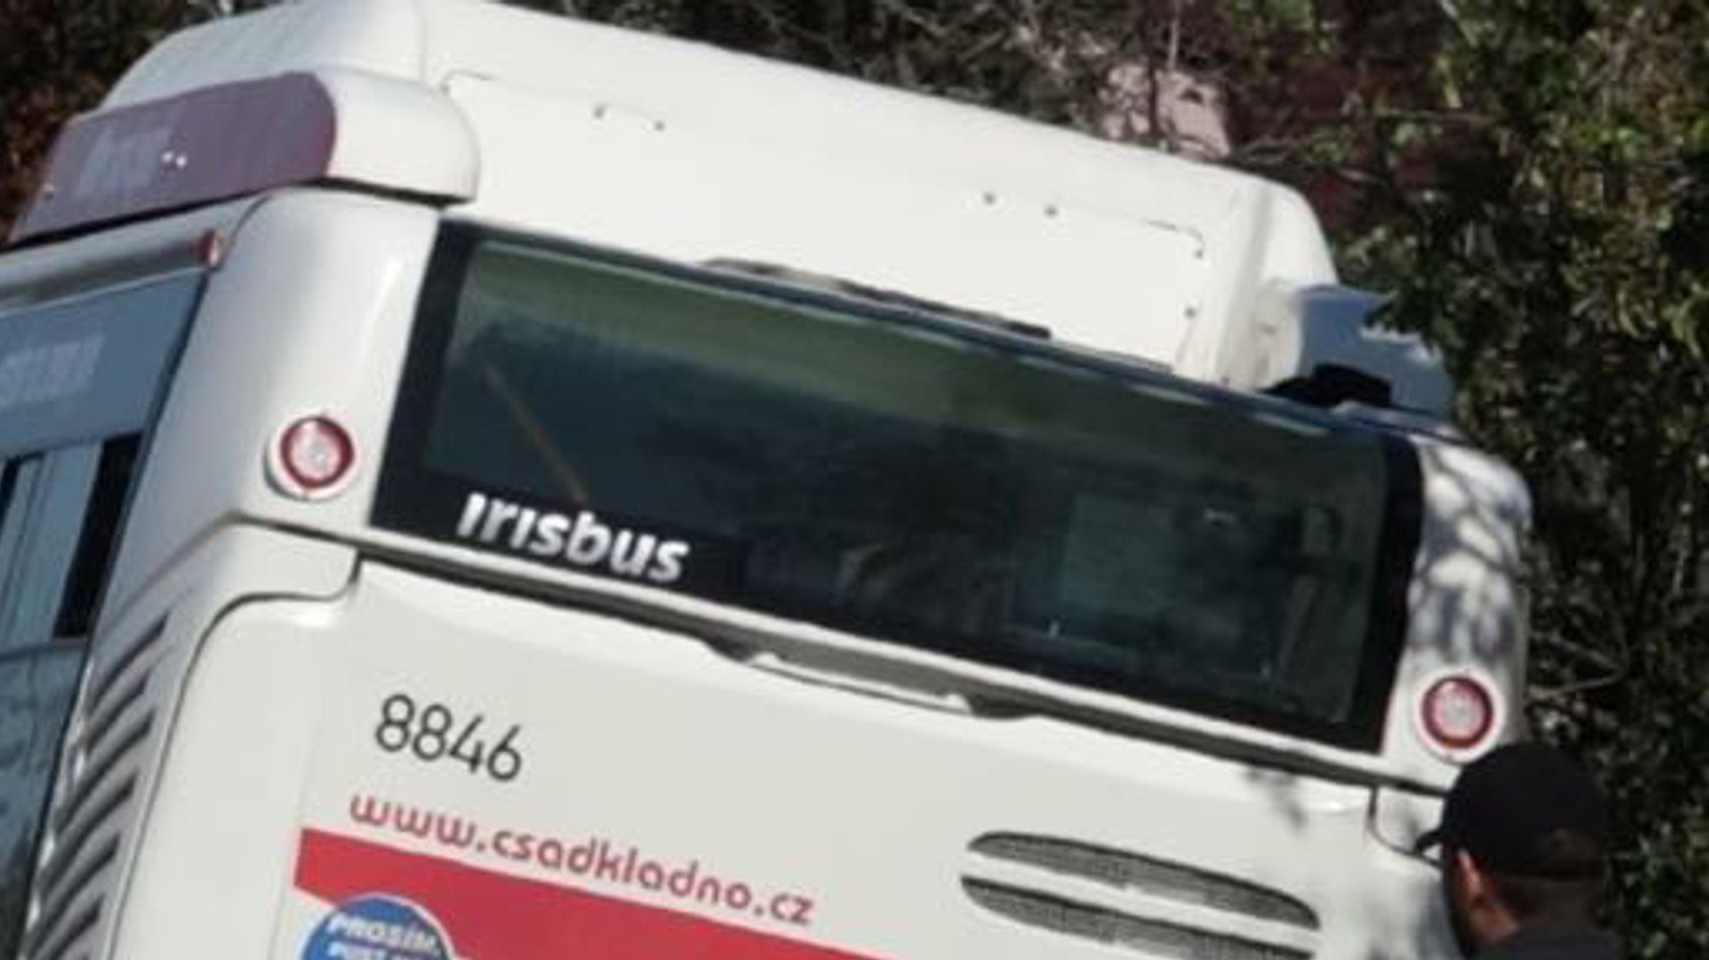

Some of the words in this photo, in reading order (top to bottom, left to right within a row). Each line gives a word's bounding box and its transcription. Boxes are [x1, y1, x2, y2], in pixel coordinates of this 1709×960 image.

[456, 493, 690, 583] Irisbus
[375, 693, 523, 782] 8846
[350, 794, 815, 926] www.csadkladno.cz
